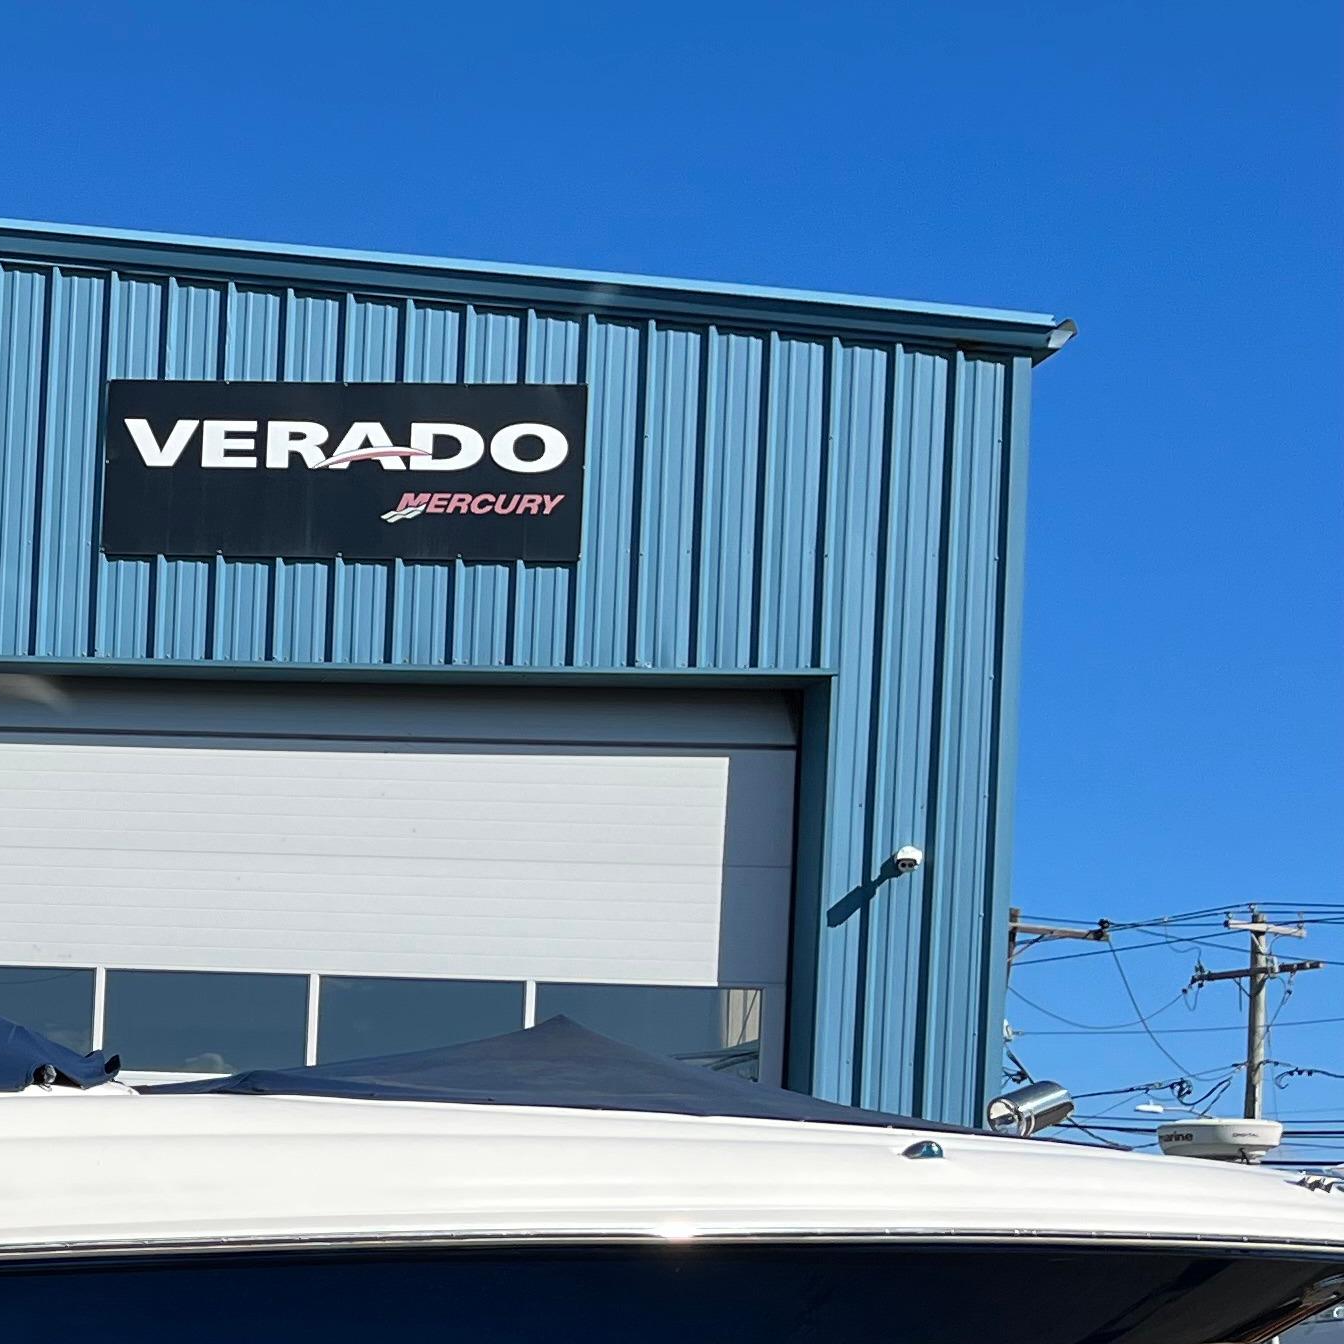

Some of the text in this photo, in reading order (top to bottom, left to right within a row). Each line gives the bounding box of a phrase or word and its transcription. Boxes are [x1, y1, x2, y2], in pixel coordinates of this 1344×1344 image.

[123, 417, 570, 474] VERADO
[395, 492, 565, 515] MERCURY
[1160, 1130, 1194, 1143] arine
